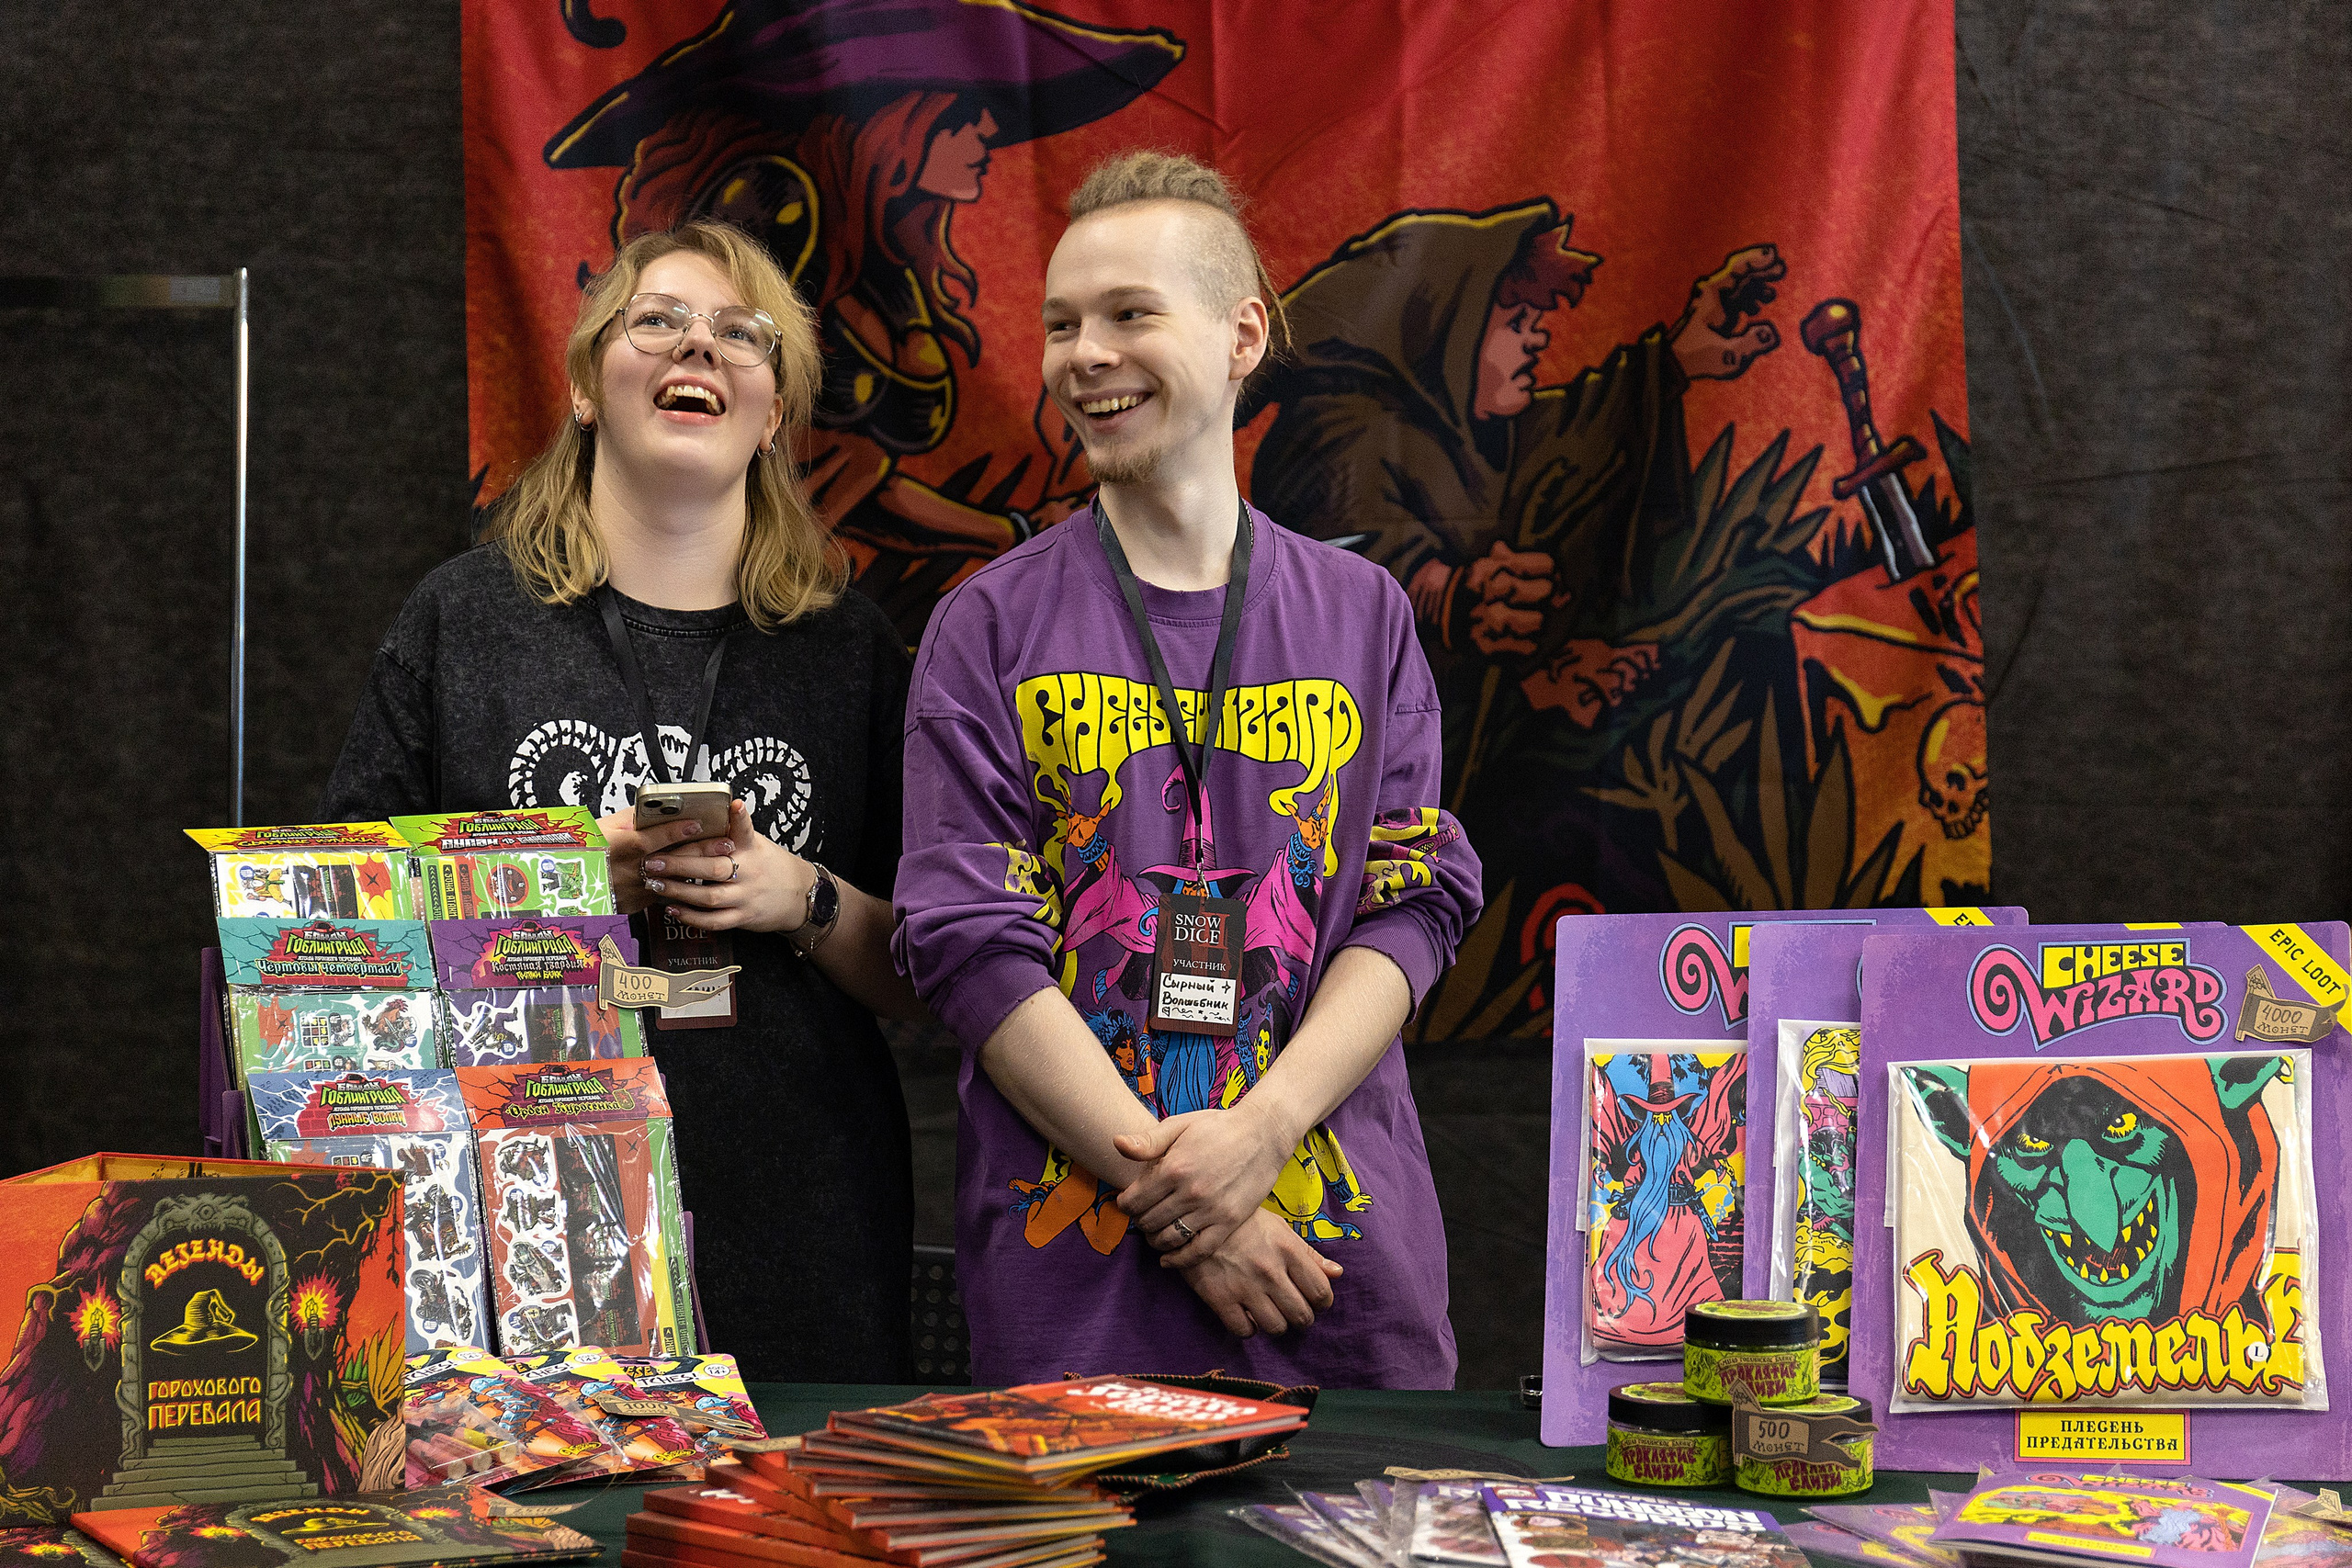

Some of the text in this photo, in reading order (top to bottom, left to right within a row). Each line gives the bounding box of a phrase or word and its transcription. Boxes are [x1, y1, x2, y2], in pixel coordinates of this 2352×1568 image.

[459, 818, 545, 834] ГОБЛИНГРАДА
[1174, 913, 1222, 929] SNOW
[285, 932, 373, 956] ГОБЛИНГРАДА
[494, 933, 577, 955] ГОБЛИНГРАДА
[1174, 926, 1221, 944] DICE
[668, 956, 718, 966] УЧАСТНИК
[1173, 958, 1227, 972] УЧАСТНИК
[2041, 942, 2186, 990] CHEESE
[2269, 928, 2342, 995] EPIC LOOT
[619, 972, 652, 990] 400
[1162, 975, 1215, 993] Сырный
[1162, 991, 1229, 1010] Волшебник
[2262, 1004, 2302, 1024] 4000
[320, 1085, 407, 1106] ГОБЛИНГРАДА
[525, 1076, 609, 1099] ГОБЛИНГРАДА
[327, 1111, 407, 1130] ЛУННЫЕ ВОЛКИ
[2254, 1346, 2264, 1358] L
[638, 1372, 700, 1386] TCHES!
[149, 1378, 261, 1401] ГОРОХОВОГО
[149, 1400, 261, 1431] ПЕРЕВАЛА
[623, 1402, 669, 1410] 1000
[1758, 1420, 1791, 1439] 500
[2061, 1419, 2144, 1434] ПЛЕСЕНЬ
[2027, 1436, 2179, 1451] ПРЕДАТЕЛЬСТВА
[1634, 1462, 1685, 1482] СЛИЗИ
[1789, 1472, 1842, 1493] СЛИЗИ
[1544, 1490, 1762, 1525] DUNGEON
